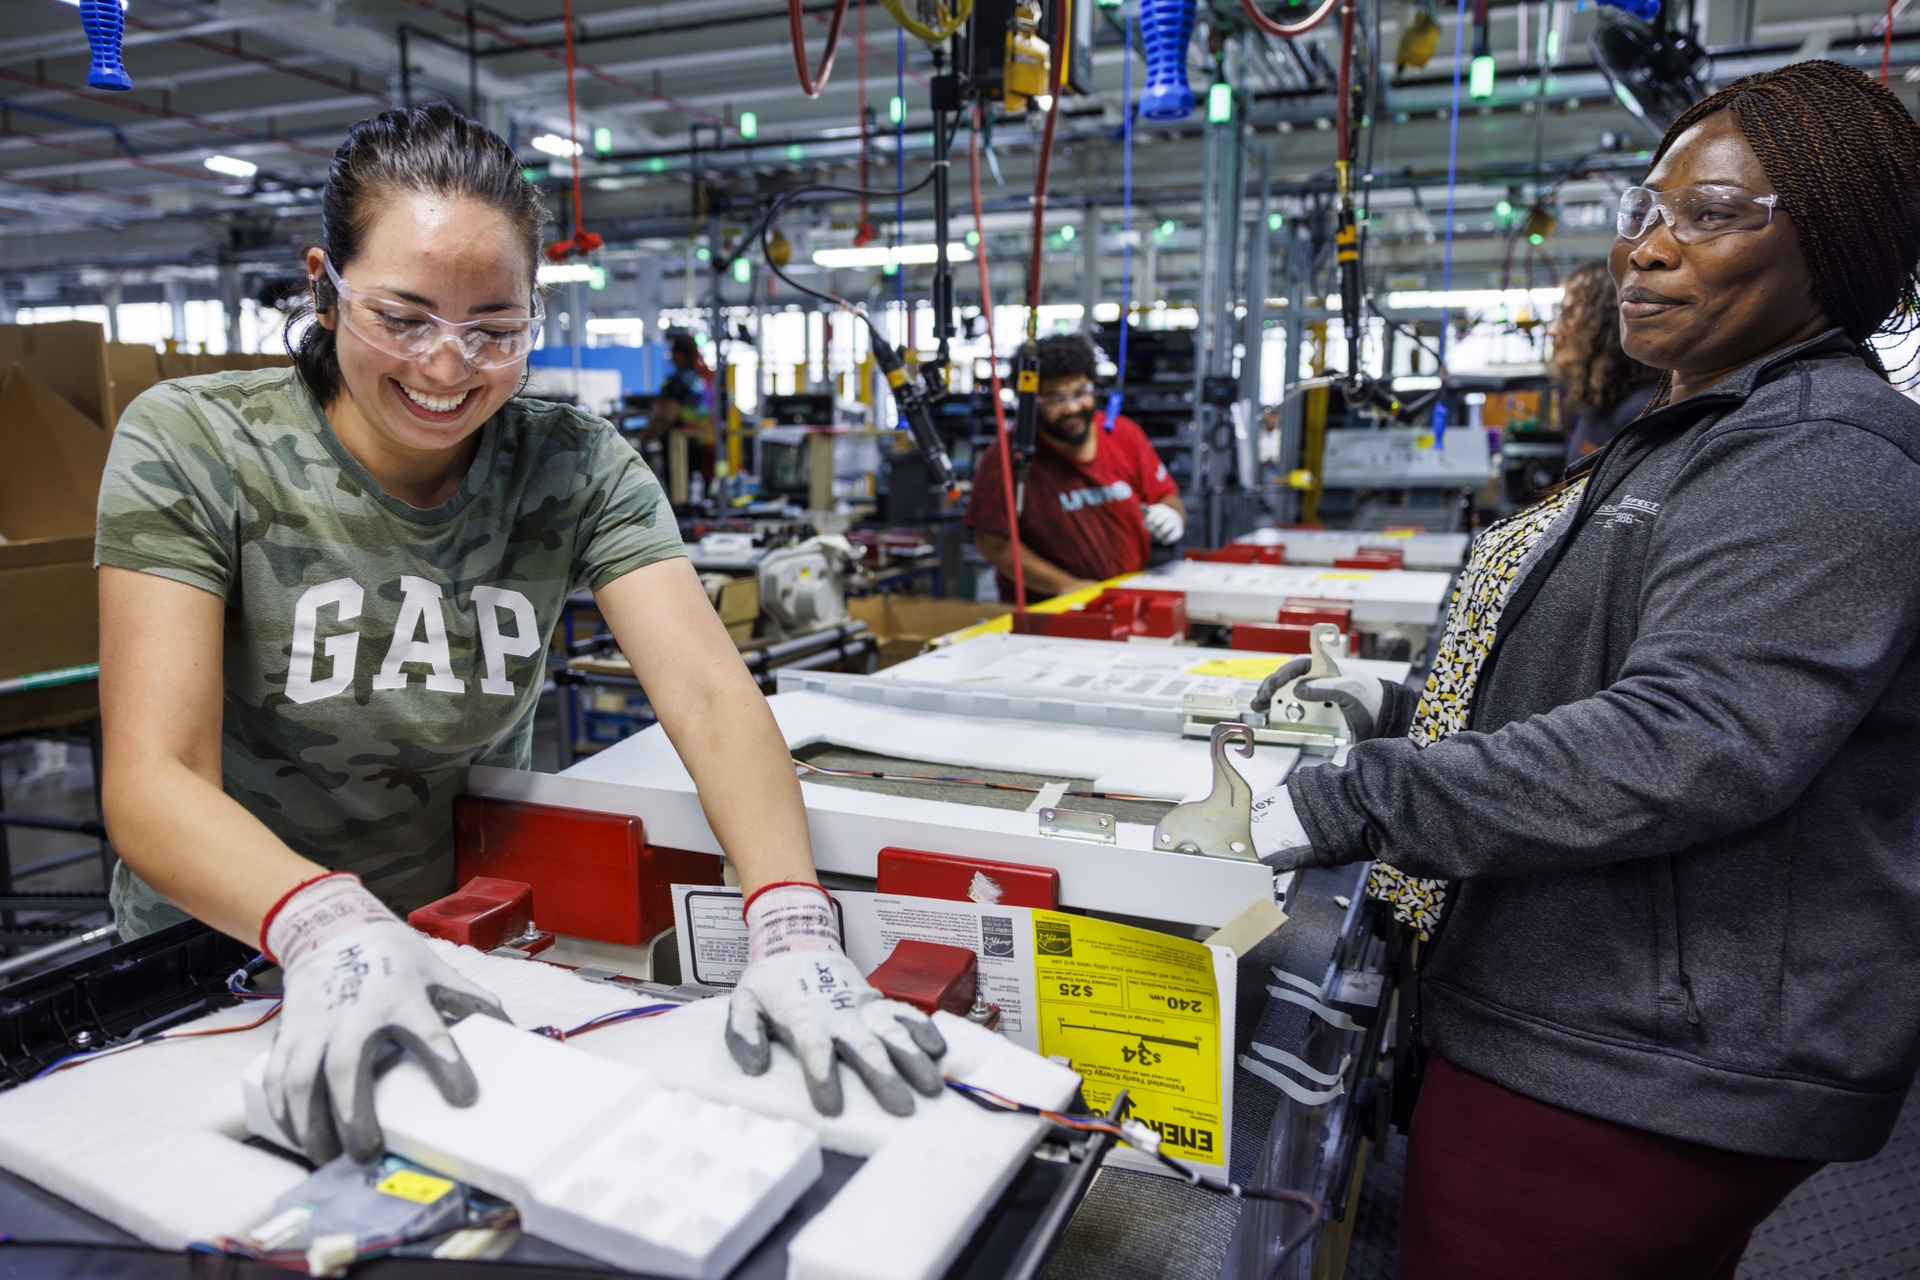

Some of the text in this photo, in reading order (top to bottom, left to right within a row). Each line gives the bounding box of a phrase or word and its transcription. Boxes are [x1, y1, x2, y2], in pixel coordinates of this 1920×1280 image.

[1624, 495, 1660, 509] EFFECT
[284, 575, 541, 704] GAP
[1251, 797, 1276, 812] lex
[1065, 959, 1076, 967] and
[1093, 962, 1109, 971] utility
[1111, 964, 1124, 972] your
[1133, 967, 1157, 978] depend
[1056, 975, 1074, 983] Energy
[1158, 972, 1169, 980] will
[1170, 973, 1184, 981] cost
[1185, 975, 1201, 985] Your
[1091, 979, 1118, 988] Estimated
[1059, 983, 1093, 998] $25
[1148, 993, 1202, 1013] 240 kWh
[1089, 1009, 1108, 1017] Models
[1134, 1015, 1152, 1023] Range
[1121, 1046, 1161, 1066] $34
[1074, 1067, 1185, 1092] Estimated Yearly Energy Cost
